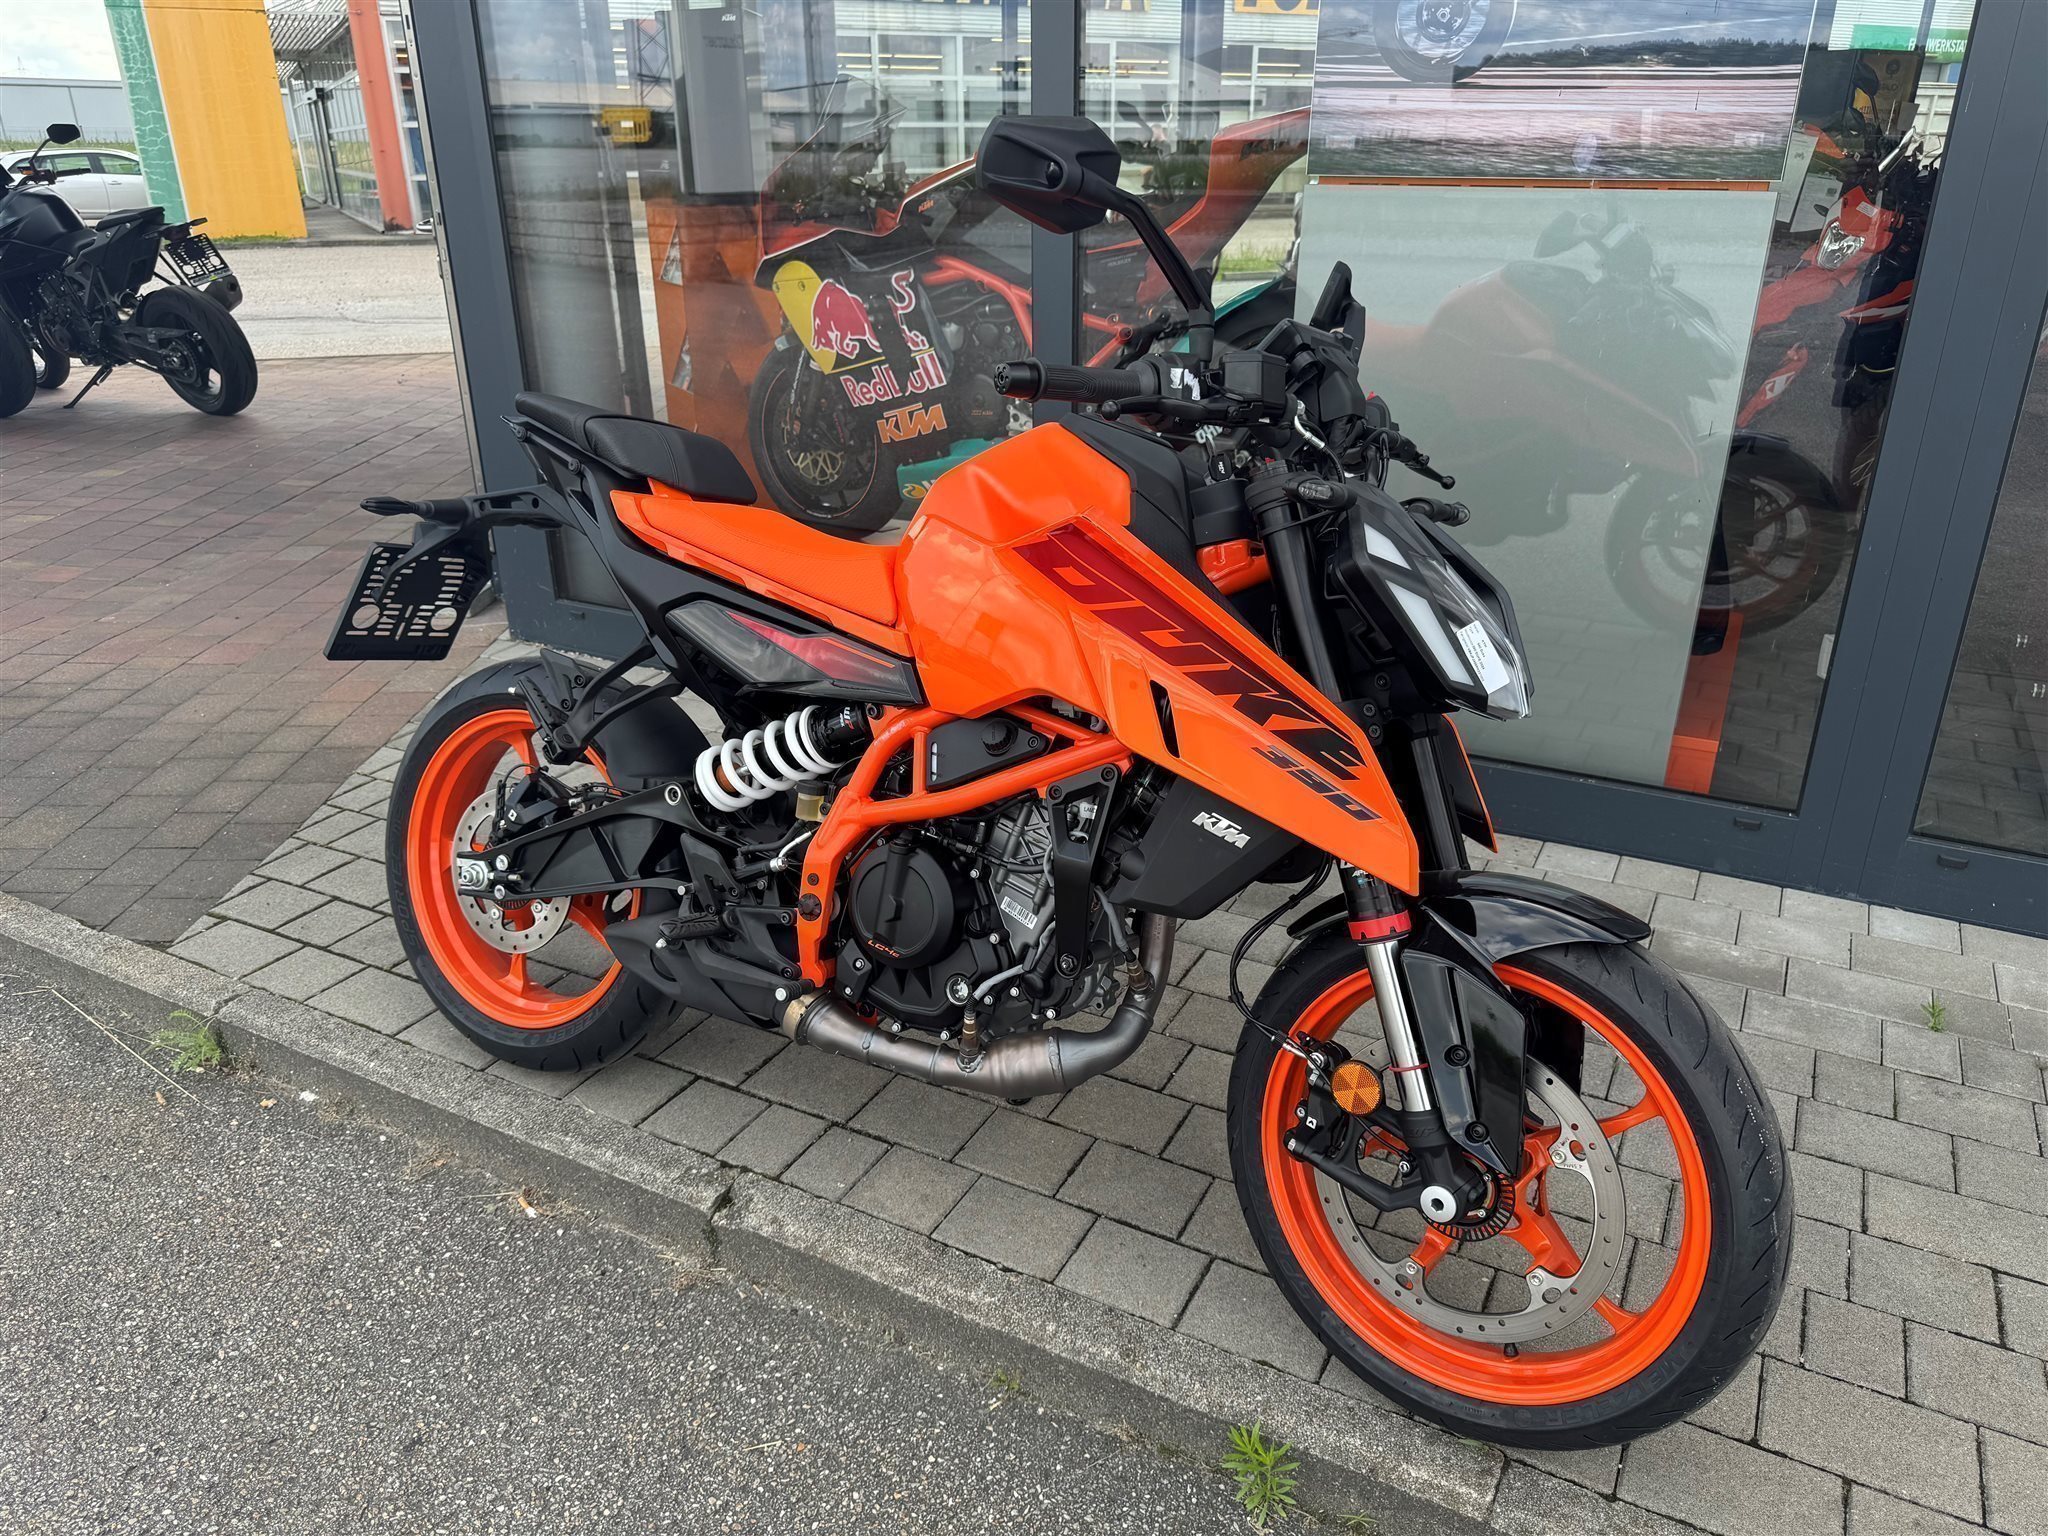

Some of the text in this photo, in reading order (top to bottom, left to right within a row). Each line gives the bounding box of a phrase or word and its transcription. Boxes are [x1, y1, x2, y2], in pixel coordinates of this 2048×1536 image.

[840, 365, 893, 407] Red
[877, 403, 947, 444] KTM
[1012, 536, 1367, 781] DUKE
[1252, 745, 1382, 821] 390
[1192, 812, 1251, 848] KTM
